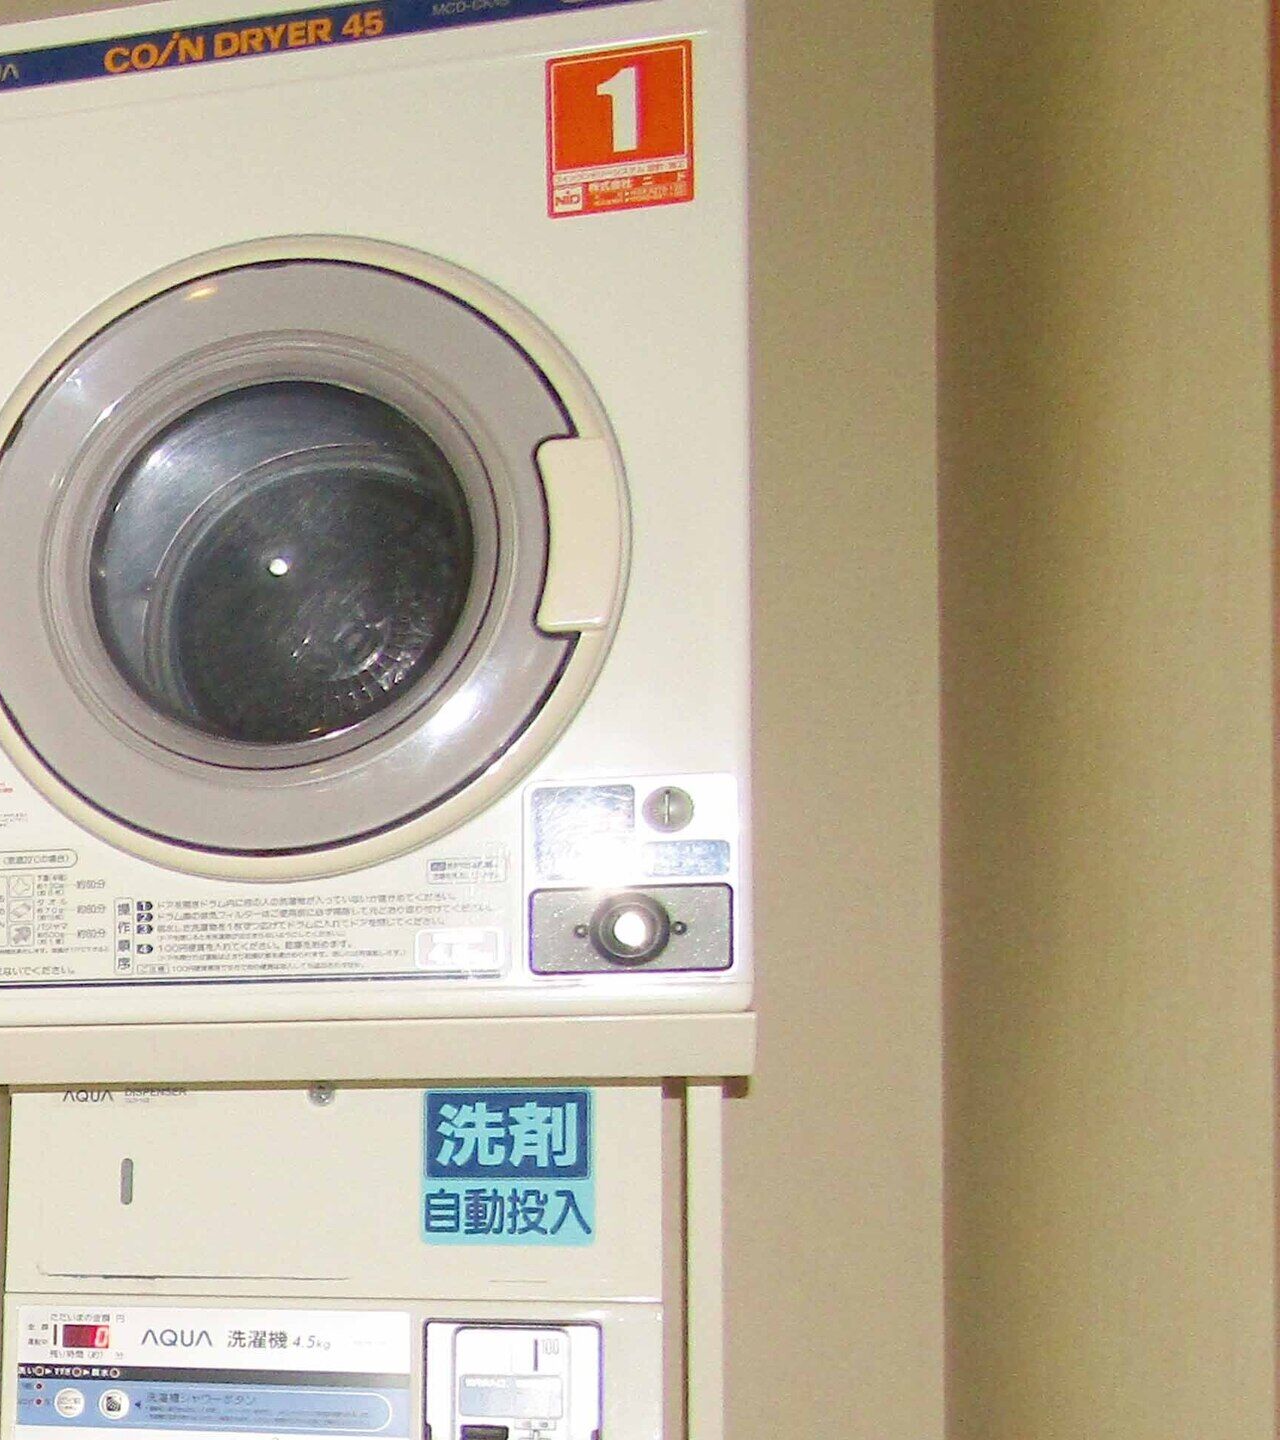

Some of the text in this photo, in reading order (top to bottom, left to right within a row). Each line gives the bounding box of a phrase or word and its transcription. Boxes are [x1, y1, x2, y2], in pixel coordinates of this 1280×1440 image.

[214, 18, 337, 61] DRYER
[341, 11, 385, 38] 45
[597, 66, 638, 153] 1
[63, 1089, 114, 1103] AQUA
[436, 1101, 579, 1168] 洗剤
[425, 1188, 592, 1236] 自動投入
[94, 1326, 109, 1348] 0
[140, 1328, 332, 1352] AQUA 洗濯機 4.5kg
